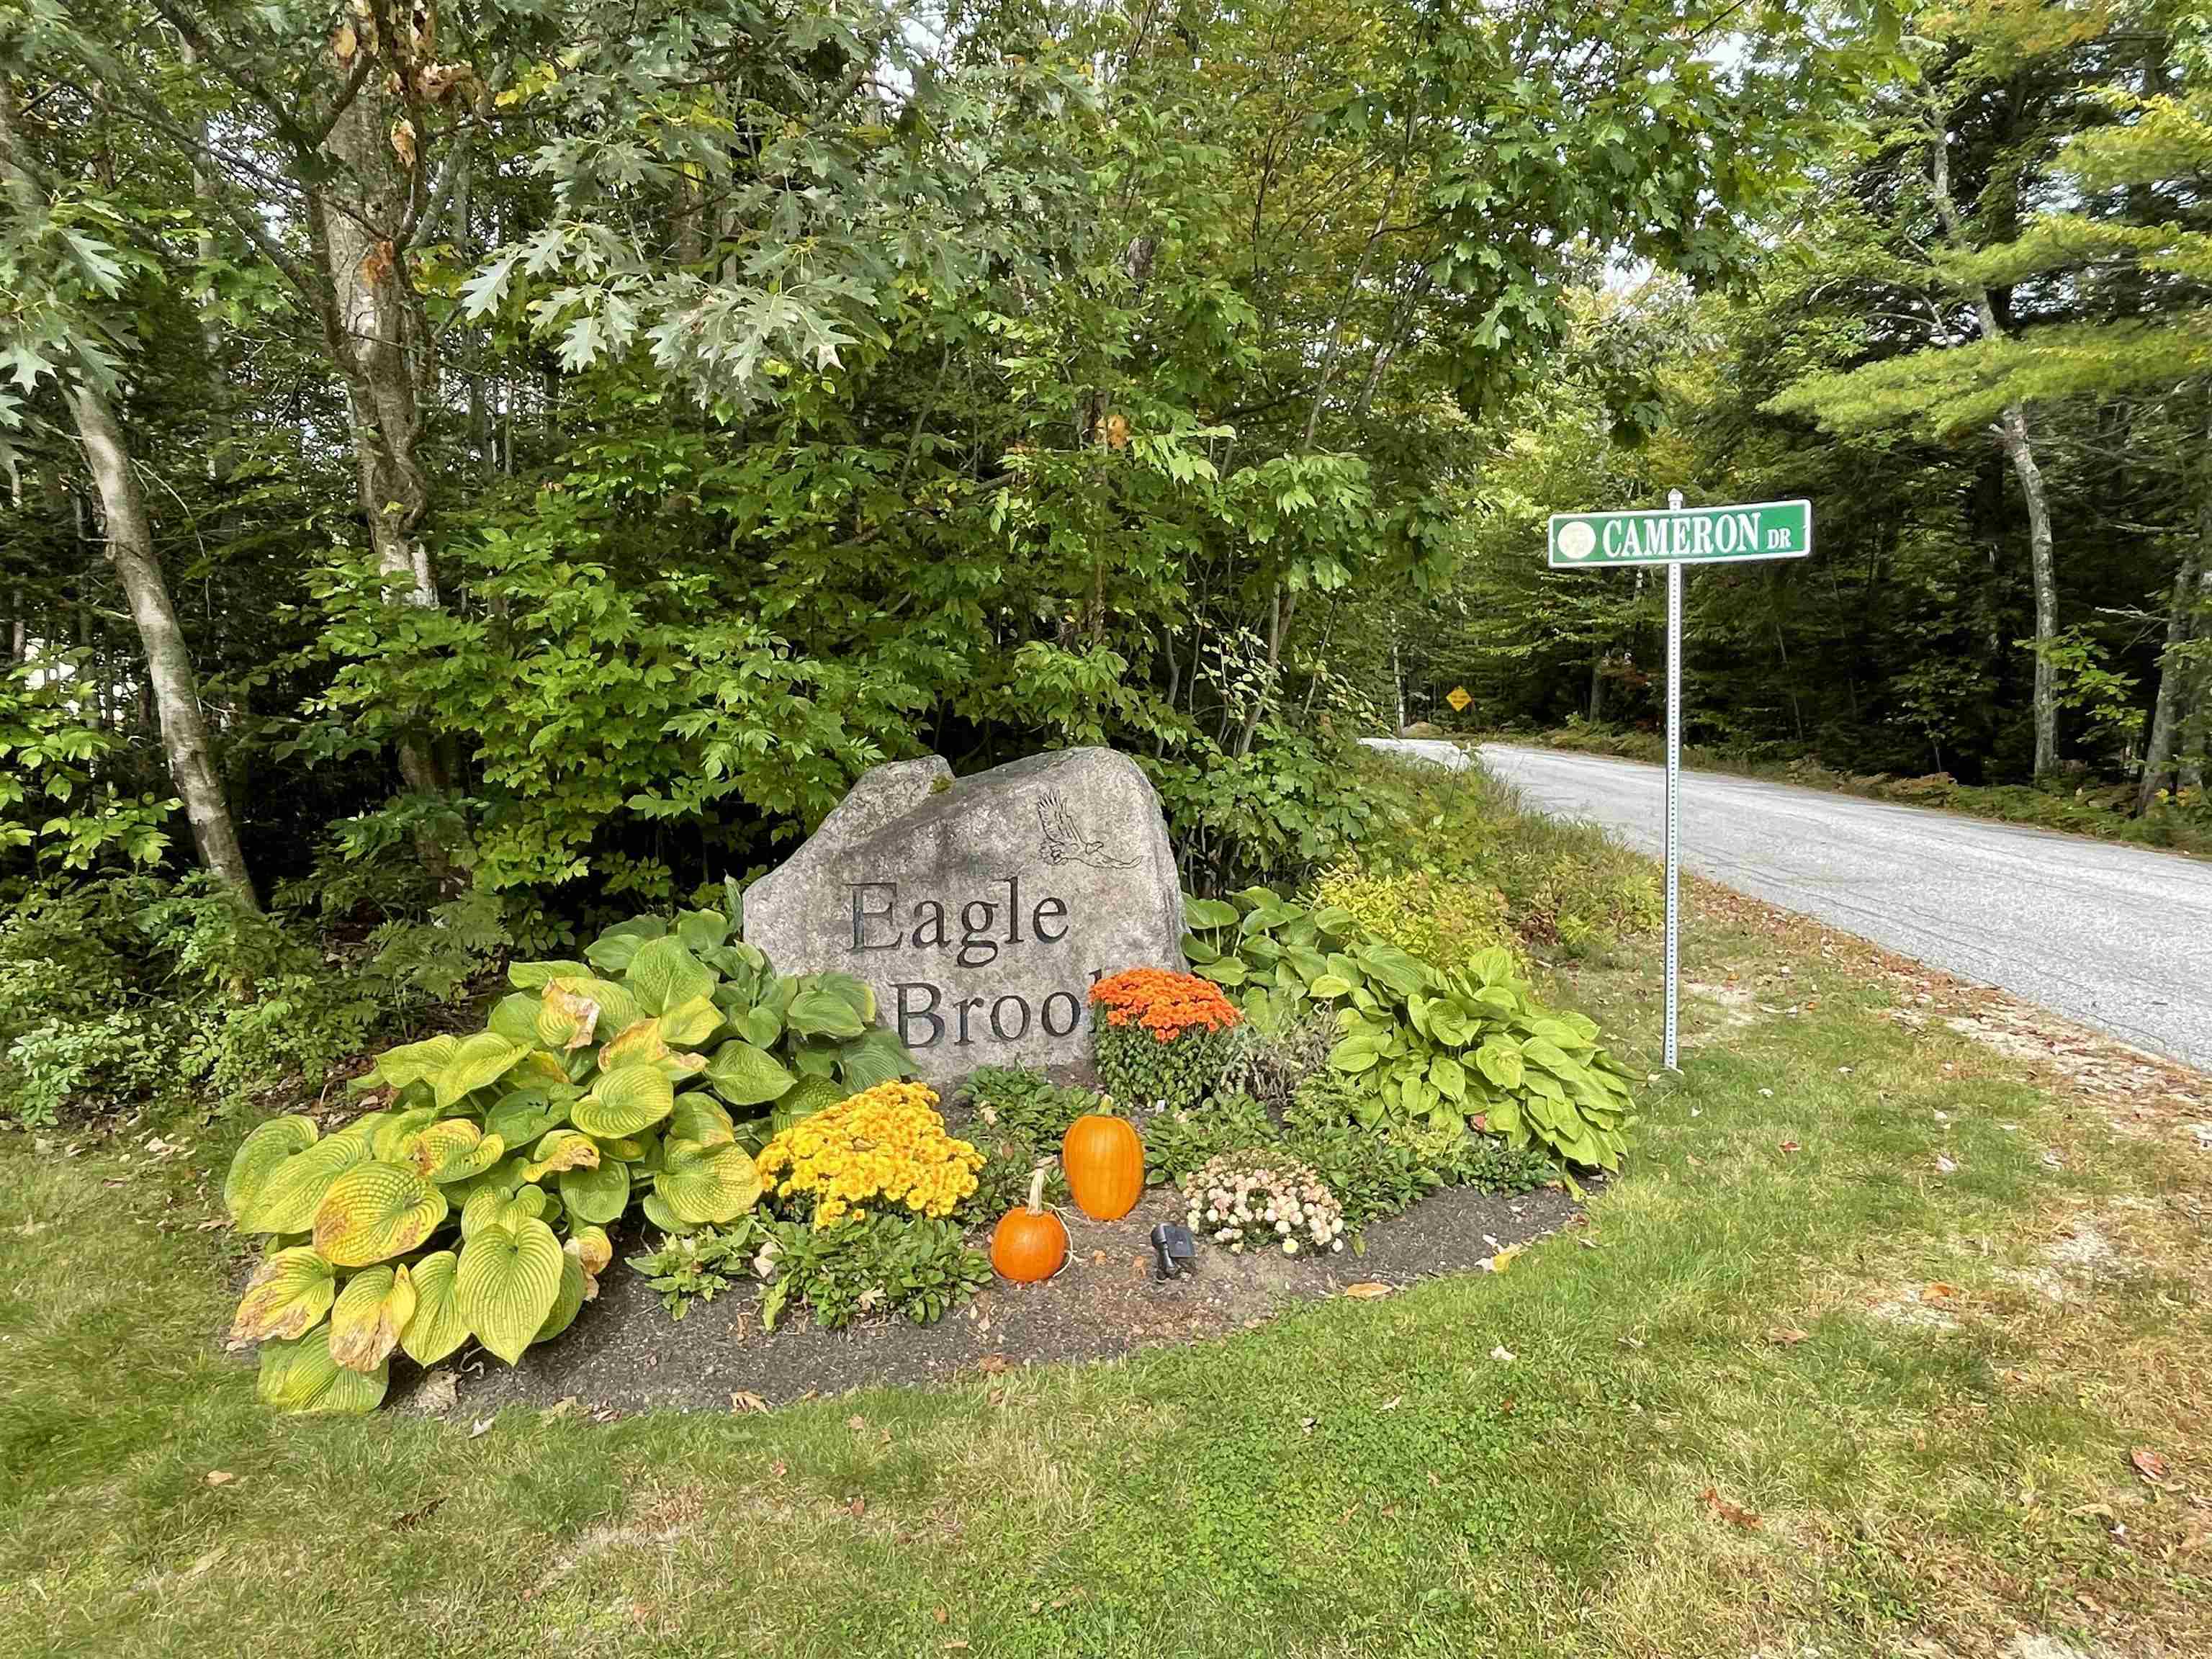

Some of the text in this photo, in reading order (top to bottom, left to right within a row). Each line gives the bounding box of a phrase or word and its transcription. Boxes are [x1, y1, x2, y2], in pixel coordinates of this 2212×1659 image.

[1602, 512, 1792, 559] CAMERON DR
[845, 876, 1069, 968] Eagle
[889, 968, 1102, 1050] Broo
